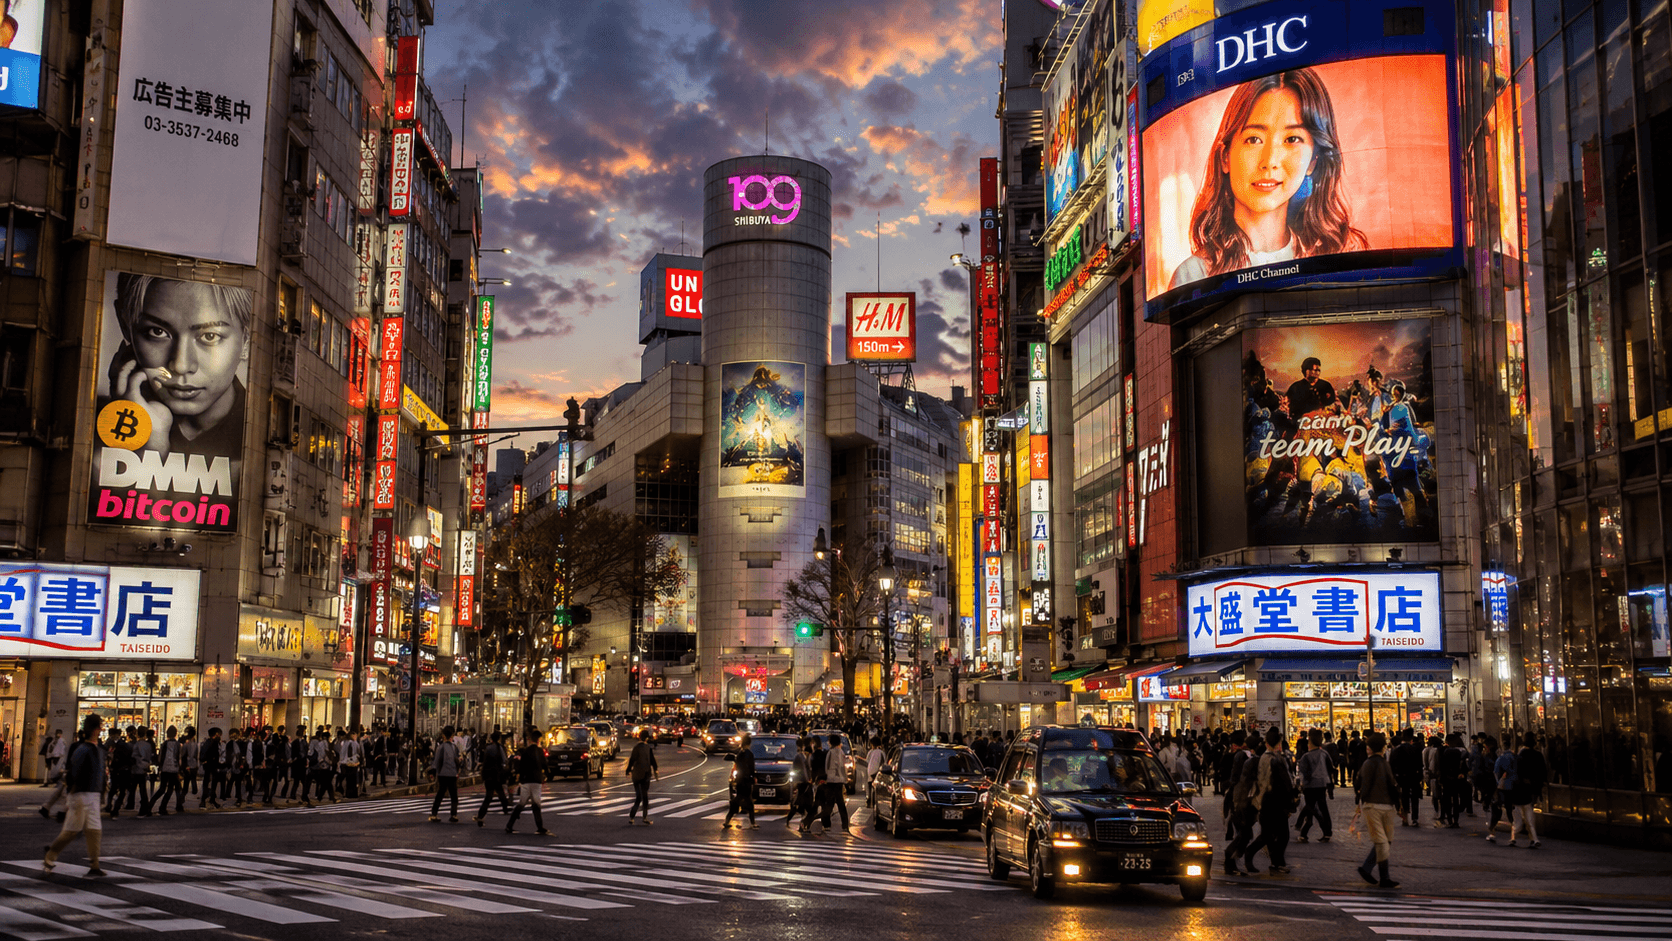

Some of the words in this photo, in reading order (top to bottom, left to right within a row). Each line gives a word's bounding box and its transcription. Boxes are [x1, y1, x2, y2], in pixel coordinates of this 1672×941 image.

[1215, 15, 1308, 73] DHC
[132, 77, 251, 124] 広告主募集中
[144, 115, 240, 147] 03-3537-2468
[728, 175, 802, 224] 109
[734, 215, 772, 226] SHIBUYA
[671, 274, 697, 292] UN
[1237, 270, 1259, 284] DHC
[670, 295, 703, 314] GL
[855, 302, 907, 332] H&M
[858, 341, 889, 352] 150m
[1260, 431, 1336, 459] team
[99, 447, 232, 496] DMM
[96, 489, 231, 526] bitcoin
[1193, 586, 1423, 639] 大盛堂書店
[120, 643, 171, 654] TAISEIDO
[1381, 637, 1425, 646] TAISEIDO
